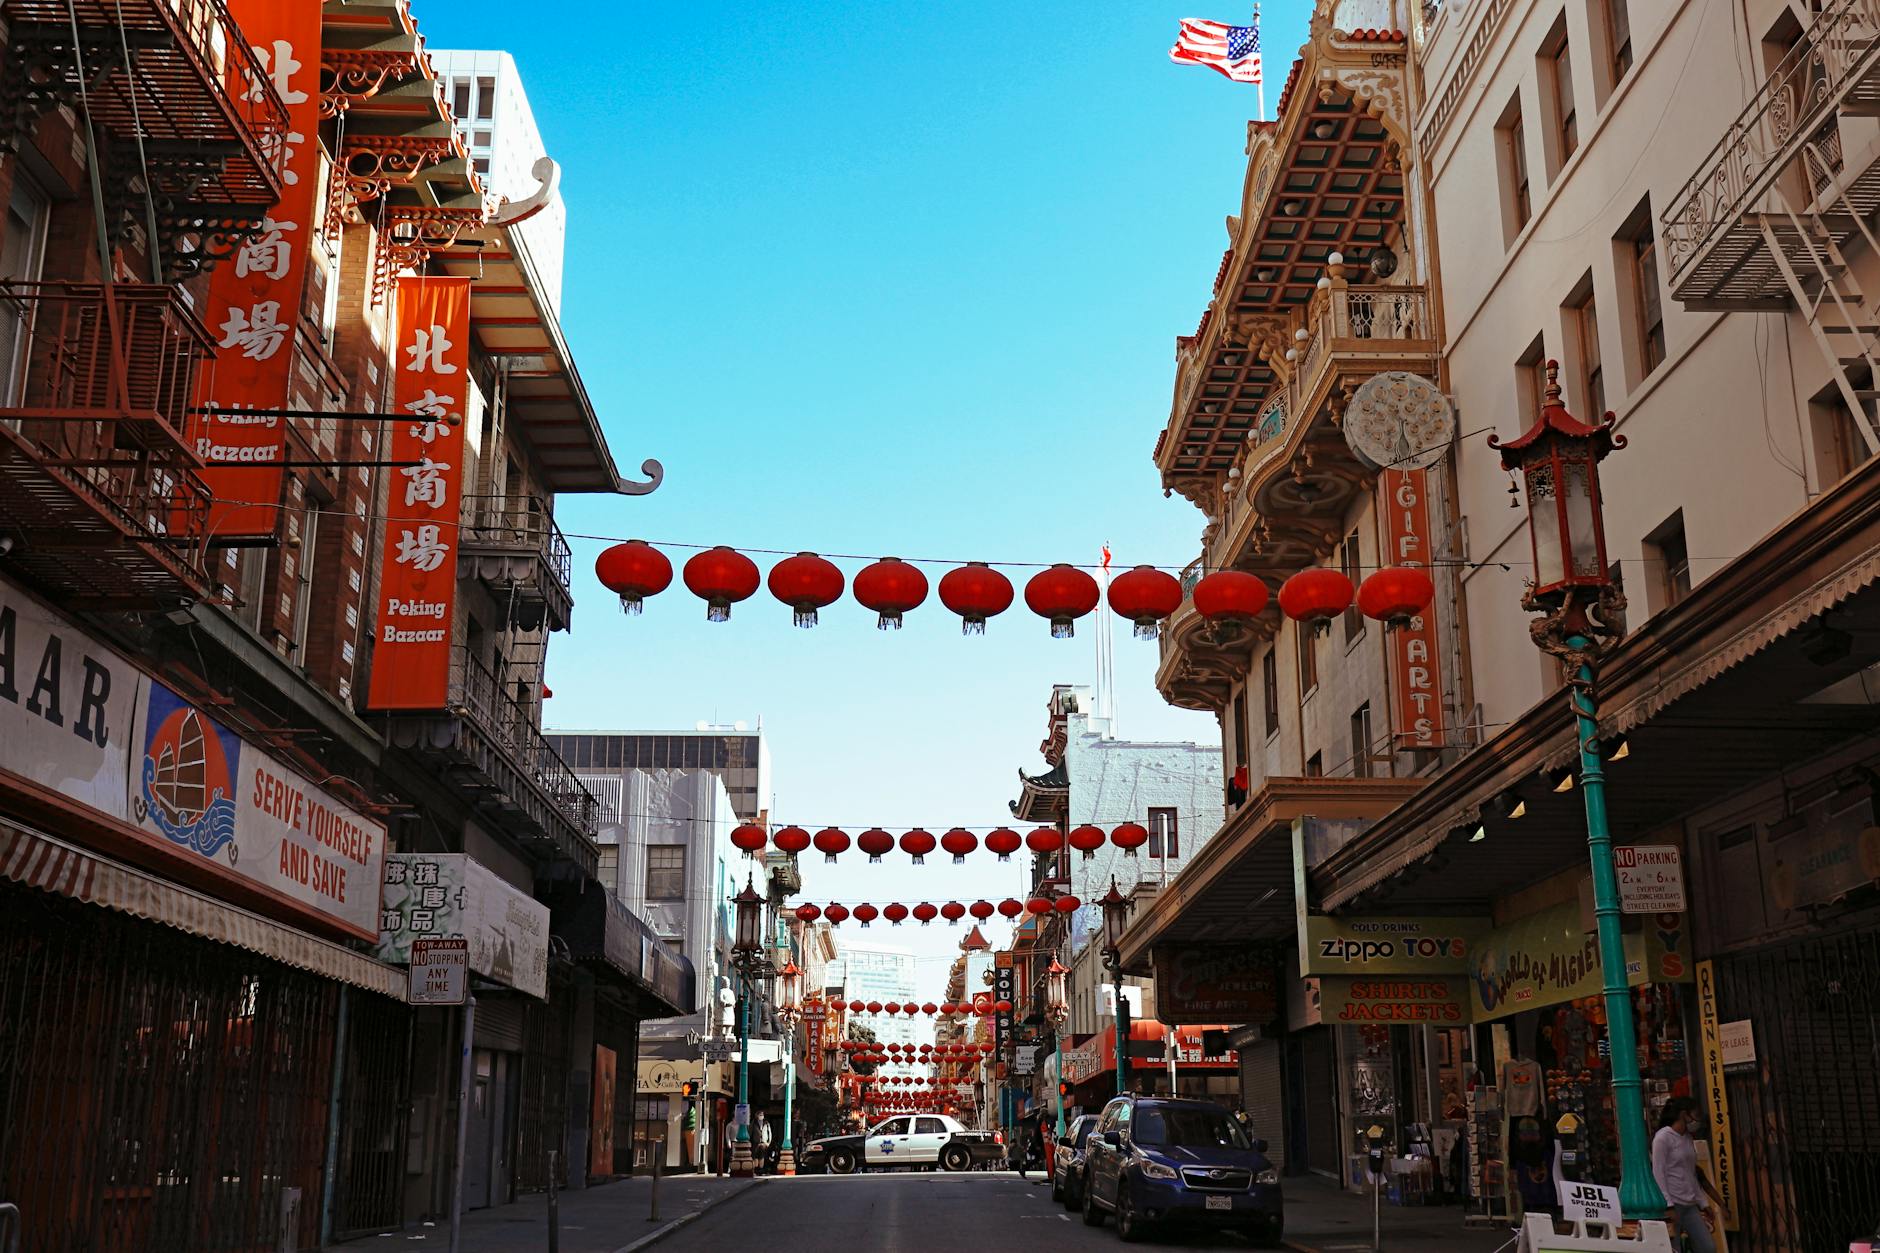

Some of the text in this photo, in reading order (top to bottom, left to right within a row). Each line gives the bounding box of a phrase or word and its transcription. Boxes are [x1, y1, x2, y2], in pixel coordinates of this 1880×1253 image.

[196, 437, 279, 462] Bazaar
[395, 325, 458, 572] 北京商場
[1396, 485, 1424, 568] GIF
[387, 598, 445, 619] Peking
[1410, 614, 1424, 632] &
[383, 624, 446, 643] Bazaar
[1406, 639, 1433, 741] ARTS
[253, 767, 372, 866] SERVE YOURSELF
[1616, 849, 1677, 866] NO PARKING
[279, 838, 346, 904] AND SAVE
[1351, 922, 1420, 932] COLD DRINKS
[416, 941, 464, 950] TOW-AWAY
[1402, 938, 1465, 958] TOYS
[1656, 913, 1684, 977] OYS
[413, 951, 464, 965] NO STOPPING
[427, 968, 449, 979] ANY
[425, 981, 449, 992] TIME
[1351, 981, 1448, 999] SHIRTS
[1338, 1002, 1462, 1021] JACKETS
[702, 1043, 735, 1051] CLAY
[810, 1021, 819, 1070] BAKERY
[1730, 1036, 1750, 1048] LEASE
[1571, 1186, 1609, 1202] JBL
[1571, 1199, 1611, 1209] SPEAKERS
